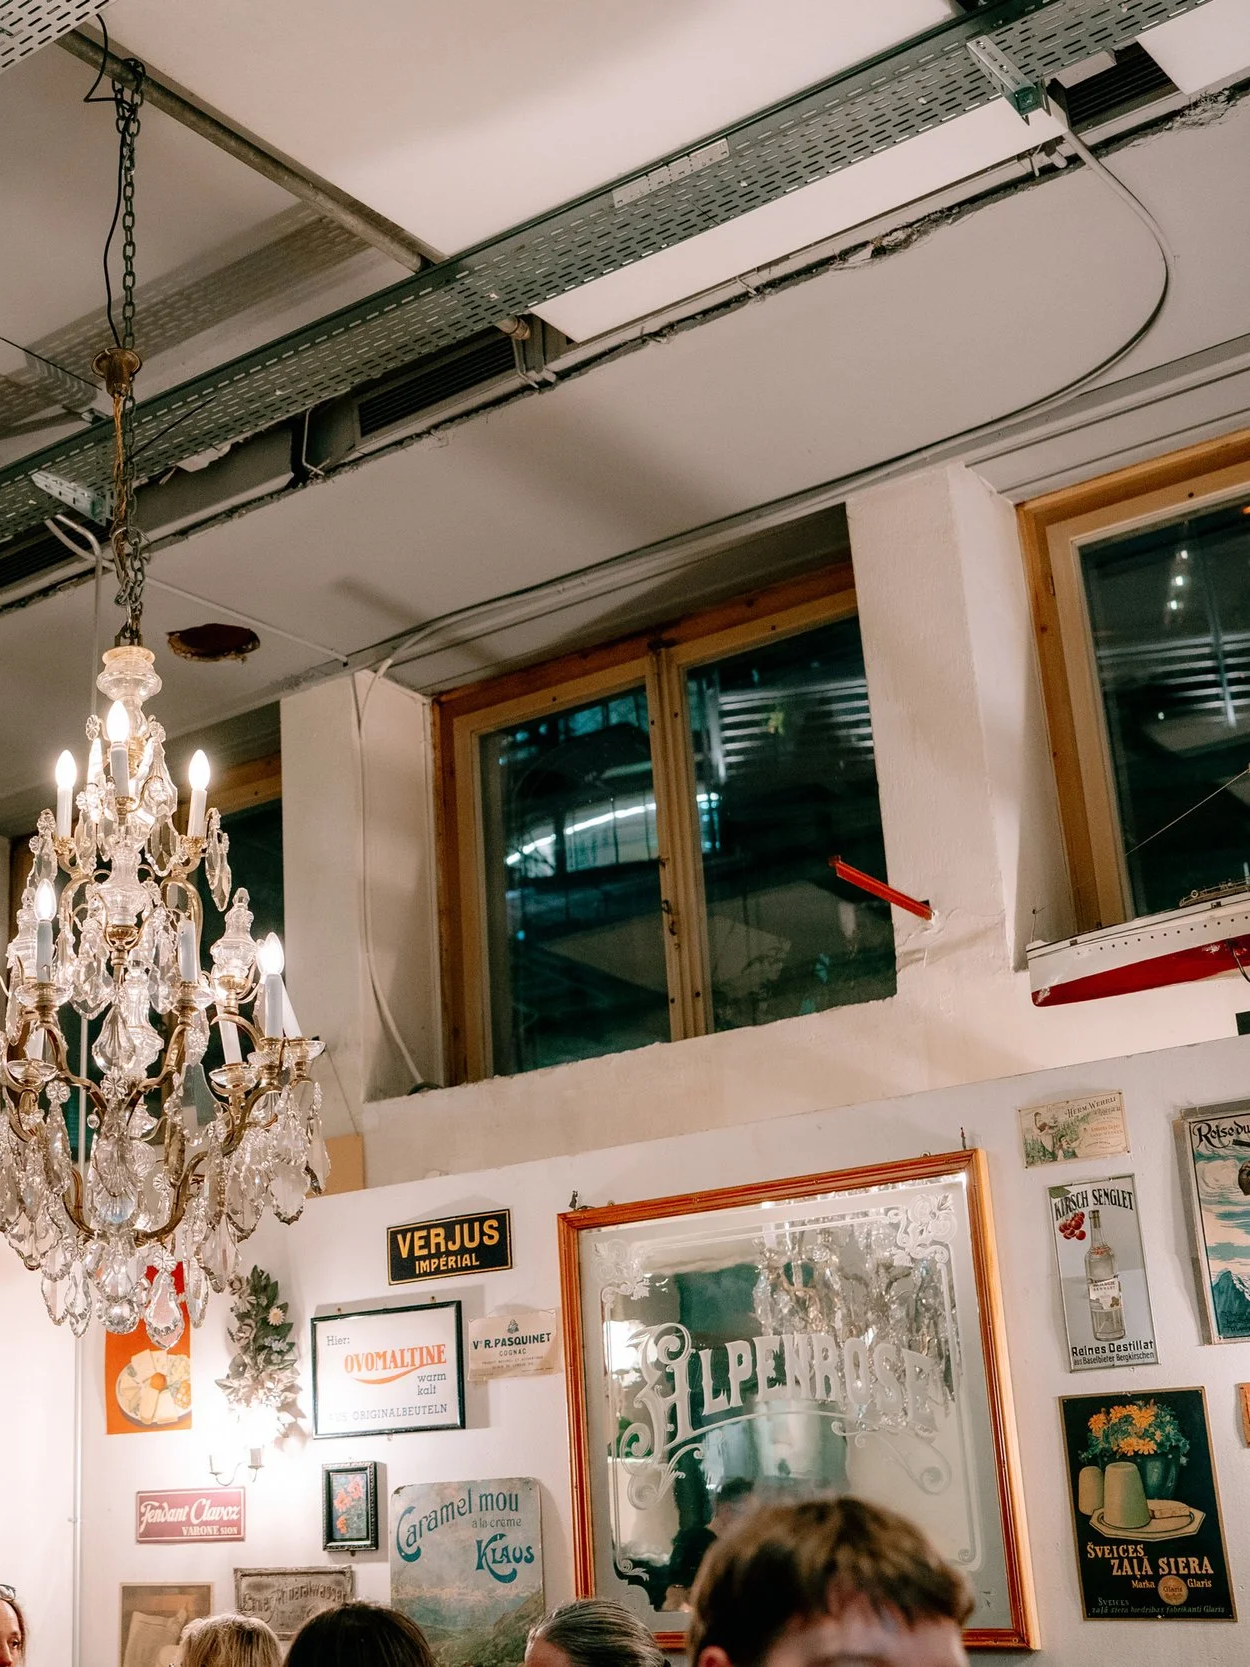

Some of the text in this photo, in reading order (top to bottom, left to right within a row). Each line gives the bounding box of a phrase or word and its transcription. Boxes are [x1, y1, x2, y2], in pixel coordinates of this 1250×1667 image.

[1192, 1121, 1234, 1149] Reise
[1054, 1188, 1134, 1221] KIRSCH SENGLET
[397, 1219, 500, 1259] VERJUS
[415, 1253, 480, 1275] IMPÉRIAL
[326, 1335, 350, 1346] Hier:
[1071, 1340, 1154, 1357] Reines Destillat
[344, 1344, 447, 1374] OVOMALTINE
[499, 1348, 527, 1357] COGNAC
[417, 1372, 447, 1383] warm
[417, 1384, 437, 1396] kalt
[352, 1404, 448, 1421] ORIGINALBEUTELN
[138, 1498, 241, 1534] Fendant Clavoz
[396, 1487, 519, 1563] Caramel mou
[181, 1526, 220, 1536] VARONE
[475, 1533, 535, 1584] KLAUS
[1086, 1541, 1145, 1559] ŠVEICES
[1111, 1556, 1214, 1579] ZAĻĀ SIERA
[1131, 1578, 1212, 1589] Marka Glaris
